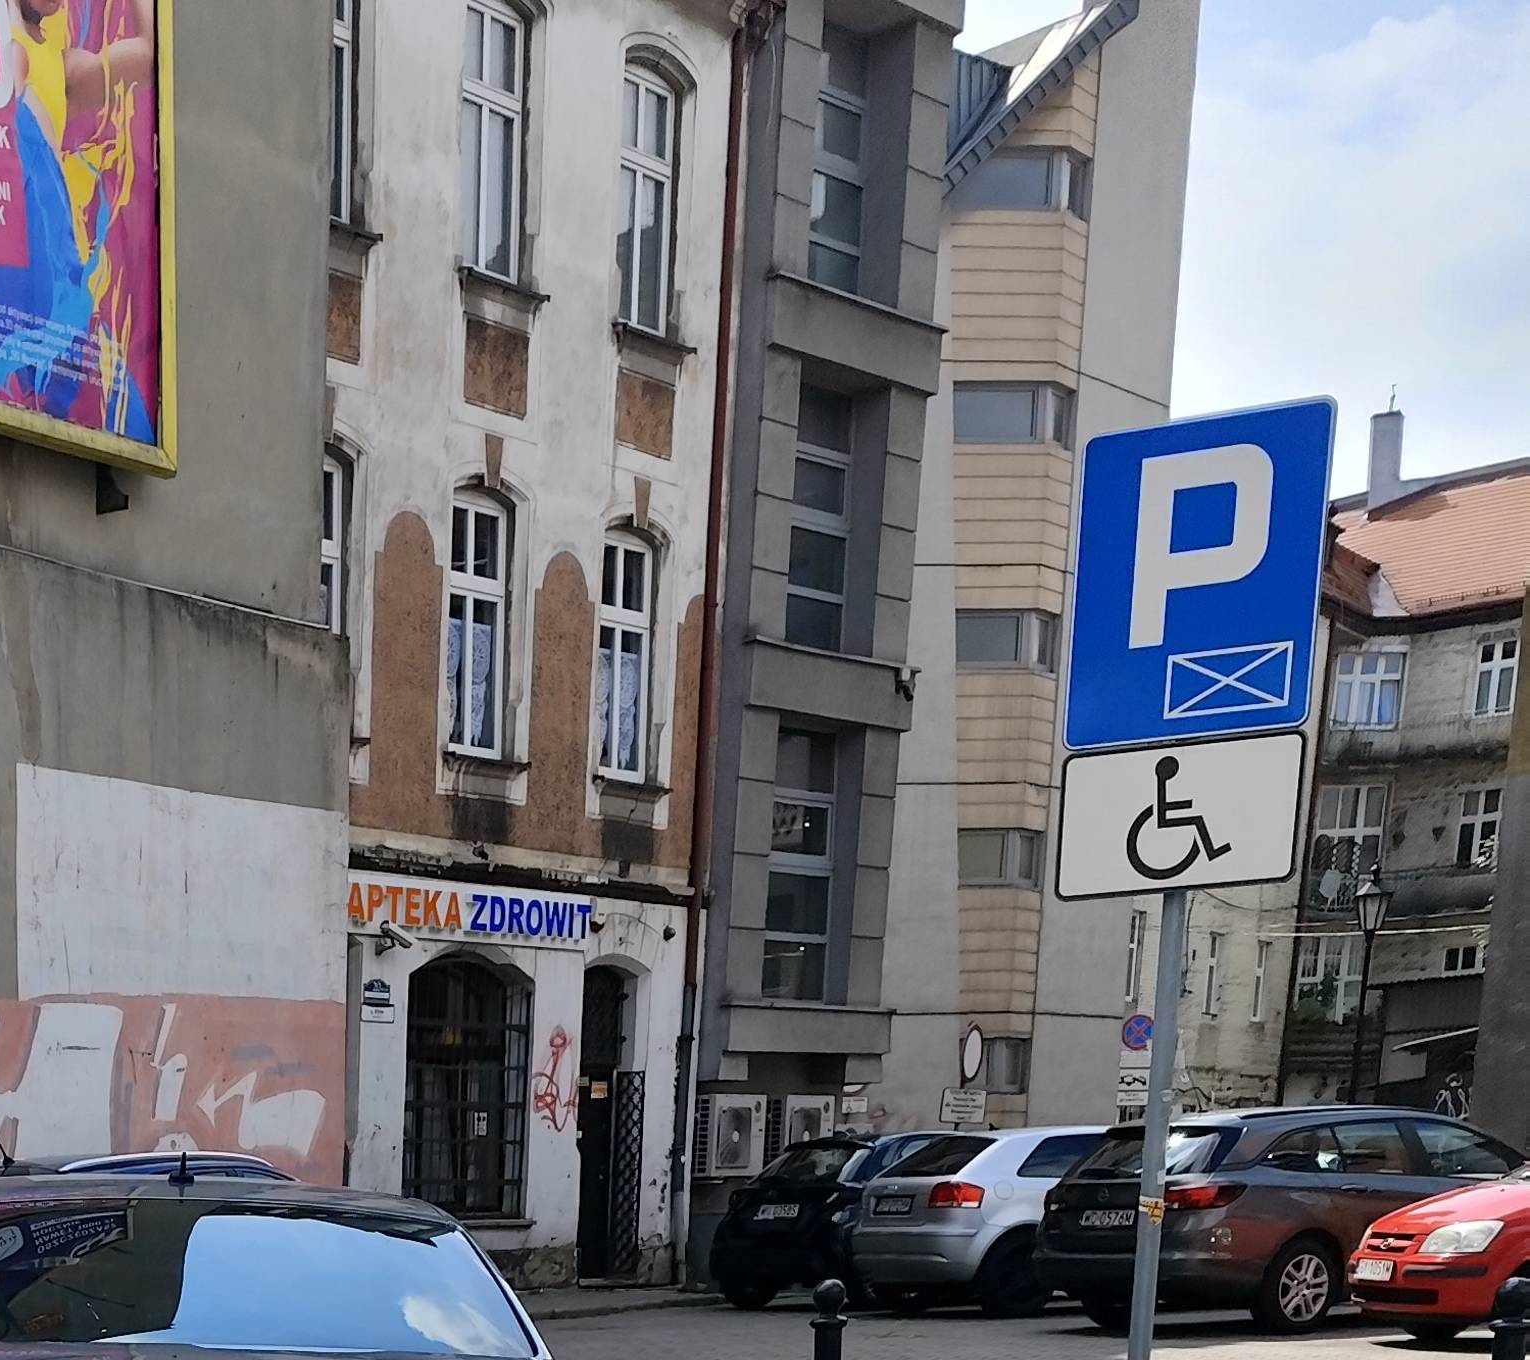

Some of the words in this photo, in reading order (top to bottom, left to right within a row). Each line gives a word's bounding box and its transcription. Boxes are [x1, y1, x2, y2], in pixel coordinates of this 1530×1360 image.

[1129, 443, 1274, 649] P
[347, 882, 462, 929] APTEKA
[471, 894, 593, 940] ZDROWIT
